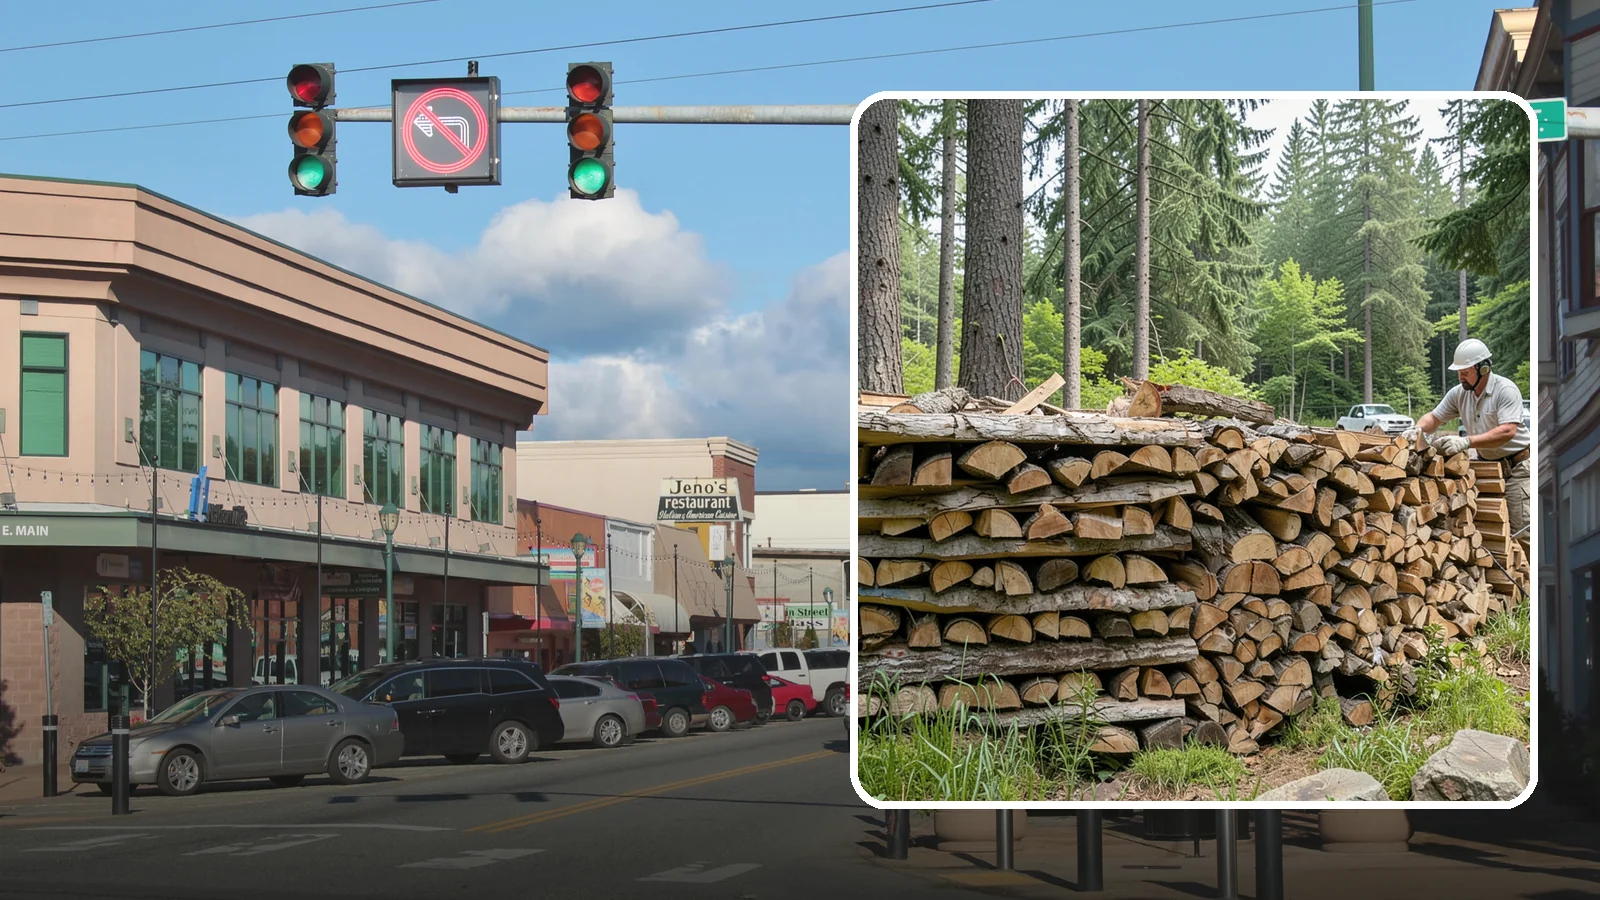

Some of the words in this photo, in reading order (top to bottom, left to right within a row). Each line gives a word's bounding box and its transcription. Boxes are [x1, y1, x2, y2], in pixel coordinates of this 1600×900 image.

[669, 480, 728, 494] Jeno's
[665, 496, 731, 509] restaurant
[658, 509, 681, 520] Italian
[686, 509, 714, 519] American
[715, 509, 738, 519] Cuisine
[2, 525, 13, 536] E.
[15, 525, 49, 536] MAIN
[797, 607, 828, 617] Street
